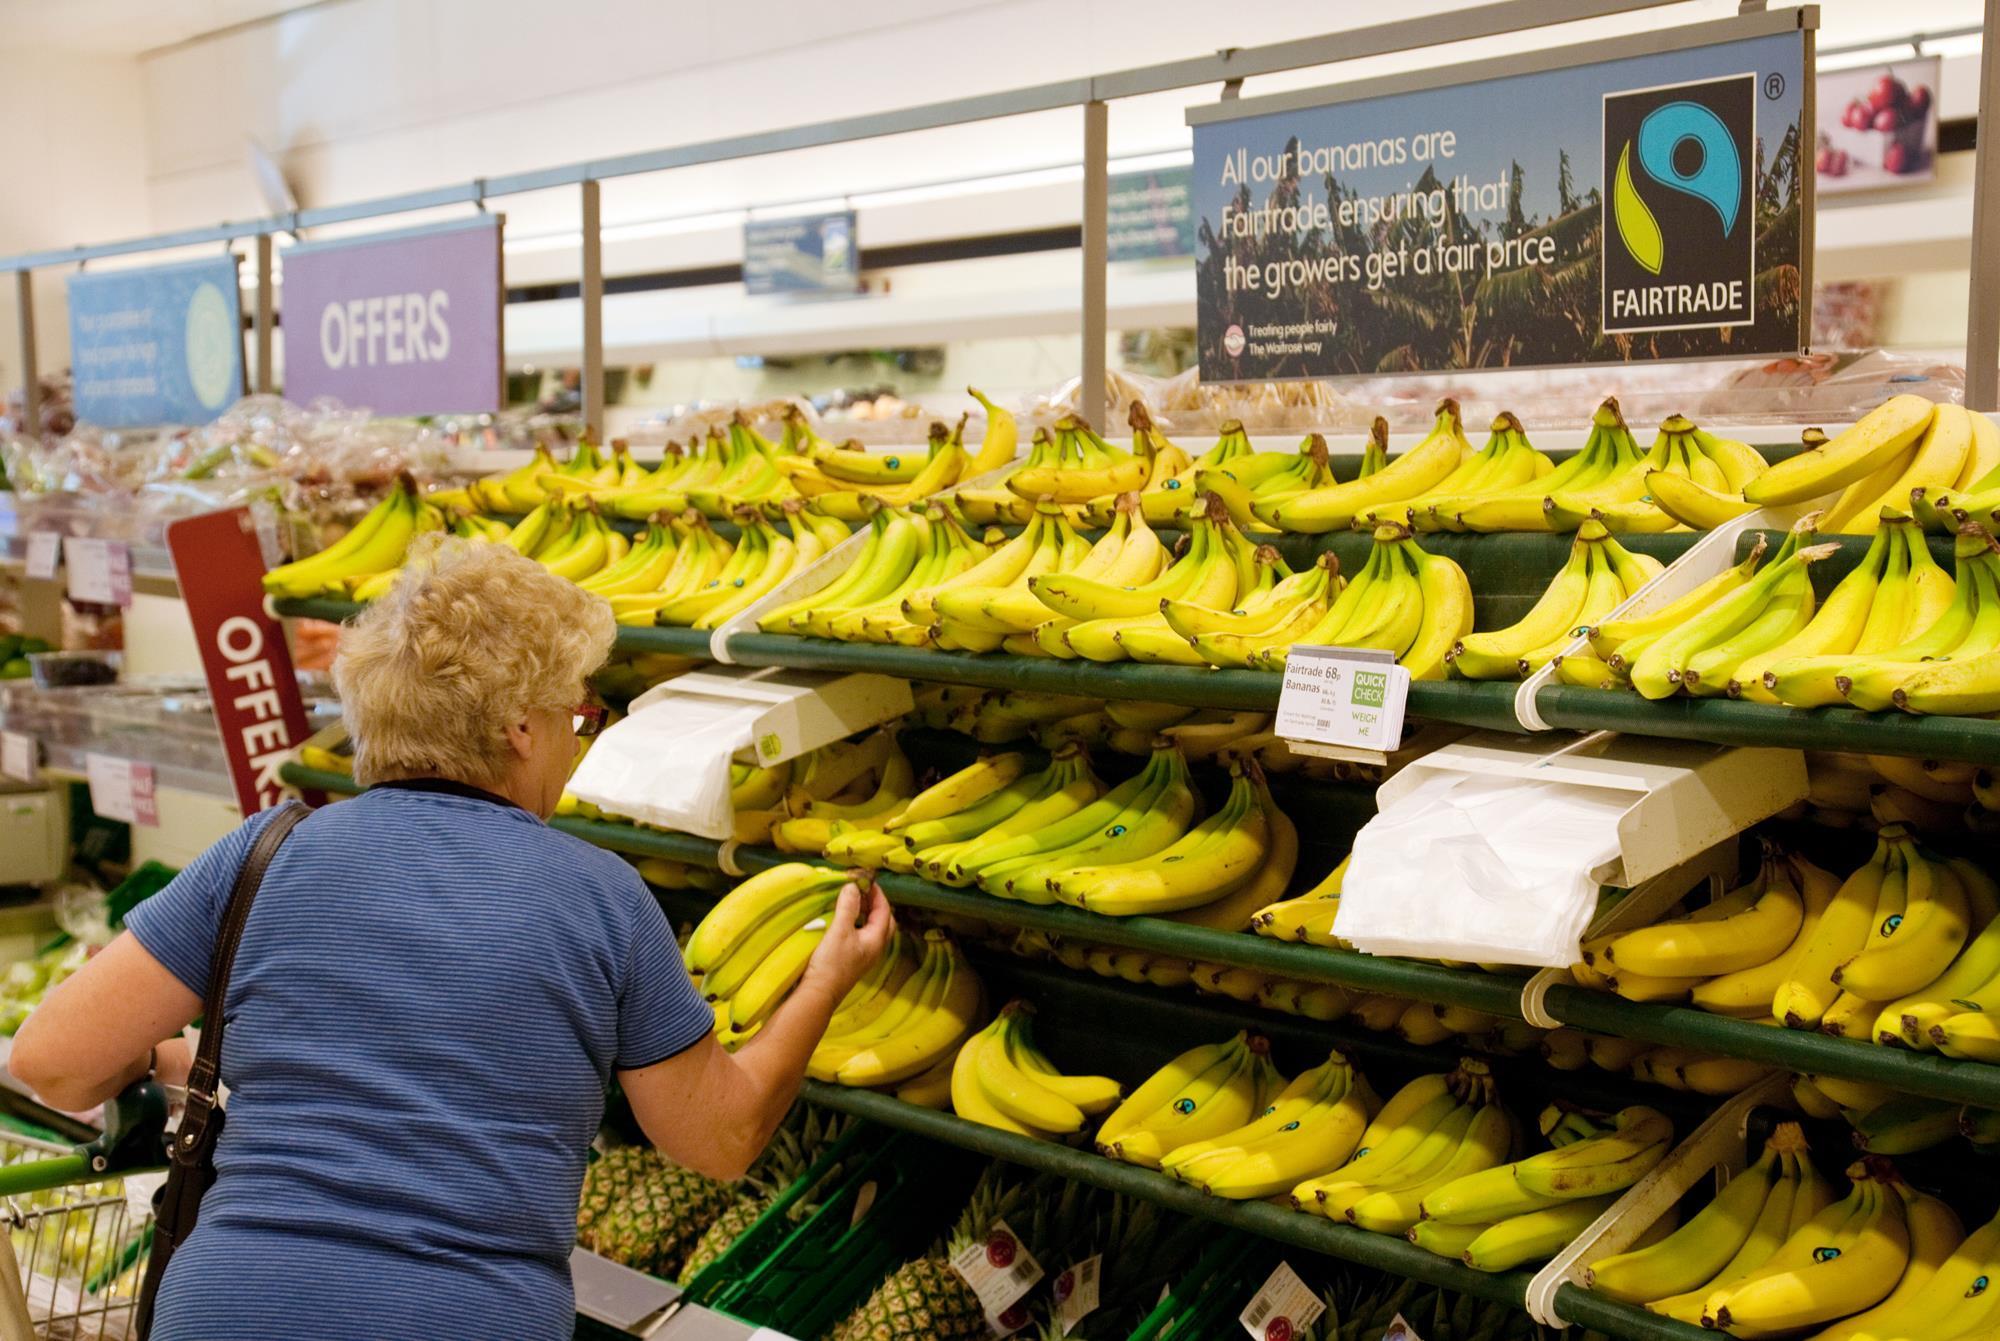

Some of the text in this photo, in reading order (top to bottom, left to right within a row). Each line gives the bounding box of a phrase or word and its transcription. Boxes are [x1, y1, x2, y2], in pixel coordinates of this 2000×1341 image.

[1221, 130, 1456, 186] All our bananas are
[1222, 193, 1334, 239] Fairtrade,
[1338, 182, 1446, 228] ensuring
[1452, 169, 1509, 214] that
[1223, 228, 1556, 299] the growers get a fair price
[1613, 280, 1743, 319] FAIRTRADE
[319, 289, 450, 371] OFFERS
[1248, 319, 1338, 339] Treating people fairly
[1249, 341, 1322, 356] The Waitrose way
[1286, 663, 1323, 678] Fairtrade
[1285, 679, 1320, 694] Bananas
[1355, 673, 1385, 688] QUICK
[1354, 687, 1383, 702] CHECK
[1352, 711, 1377, 725] WEIGH
[1359, 727, 1370, 737] ME
